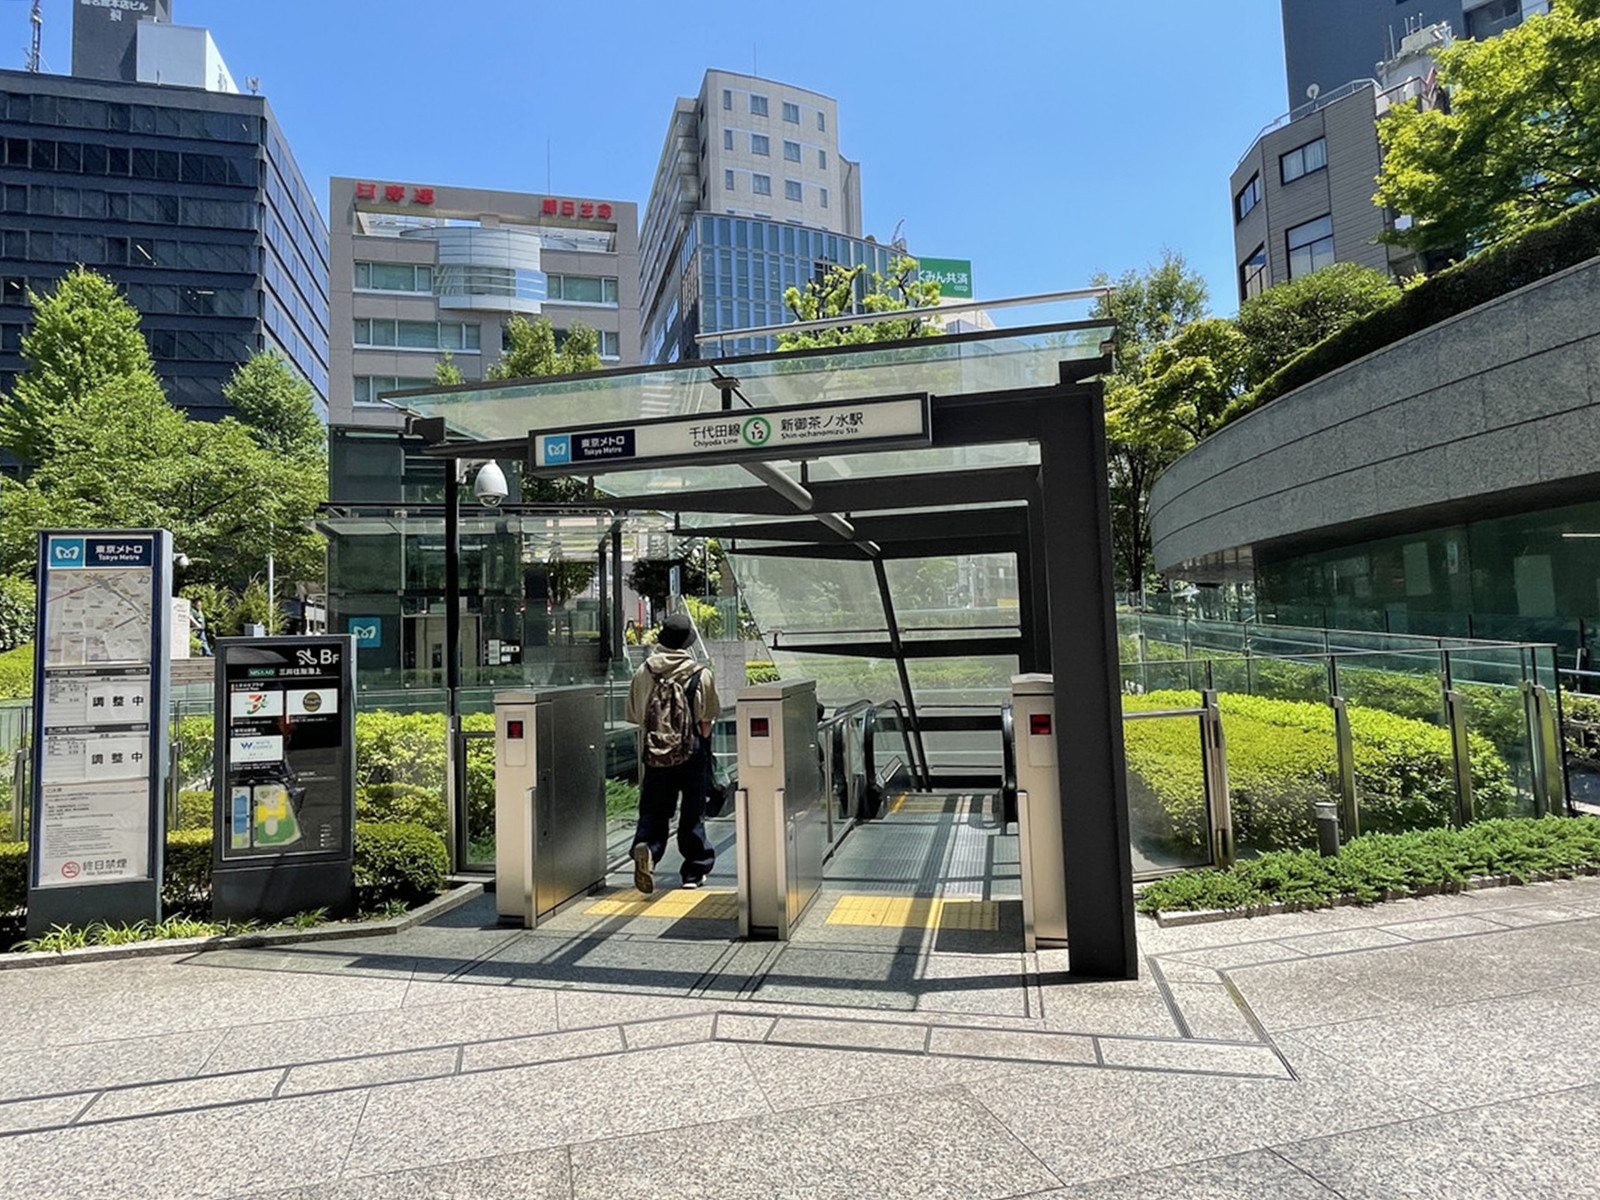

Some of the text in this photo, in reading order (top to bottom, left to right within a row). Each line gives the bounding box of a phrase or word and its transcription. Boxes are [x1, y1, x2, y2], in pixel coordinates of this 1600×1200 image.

[753, 421, 760, 430] C
[780, 412, 864, 432] 新御茶ノ水駅
[689, 424, 741, 440] 千代田線
[751, 430, 764, 440] 12
[781, 429, 844, 440] Shin-ochanomizu
[581, 436, 625, 448] 東京メトロ
[693, 440, 722, 448] Chiyoda
[584, 446, 622, 456] Tokyo Metro
[96, 545, 142, 554] 東京メトロ
[83, 859, 127, 871] 終日禁煙
